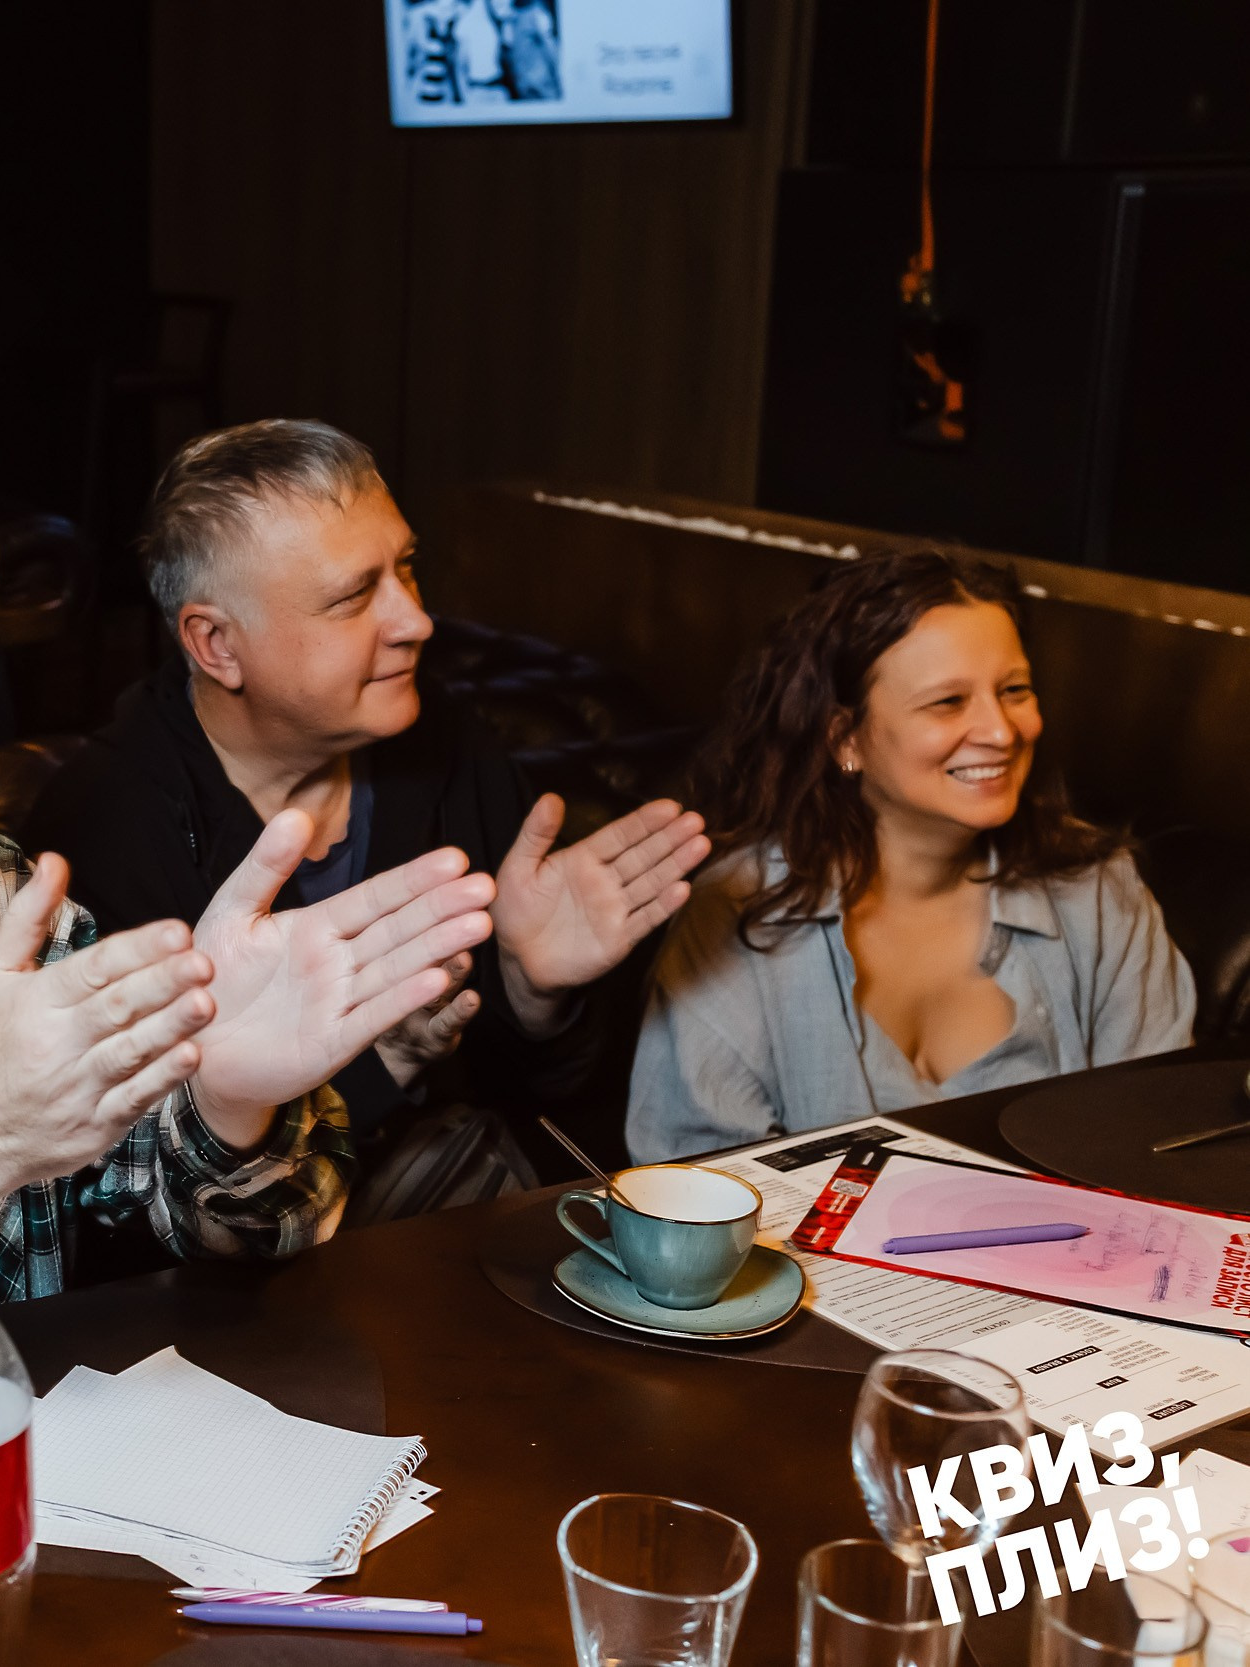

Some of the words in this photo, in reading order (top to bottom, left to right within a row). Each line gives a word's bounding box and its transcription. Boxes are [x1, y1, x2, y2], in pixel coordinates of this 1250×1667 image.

[1222, 1246, 1247, 1269] ДЛЯ
[1211, 1267, 1242, 1309] ЗАПИСИ
[972, 1319, 1011, 1335] COCKTAILS
[1065, 1347, 1096, 1360] COGNAC
[1032, 1360, 1063, 1373] BRANDY
[1102, 1377, 1123, 1387] RUM
[1153, 1401, 1192, 1419] LIQUEURS
